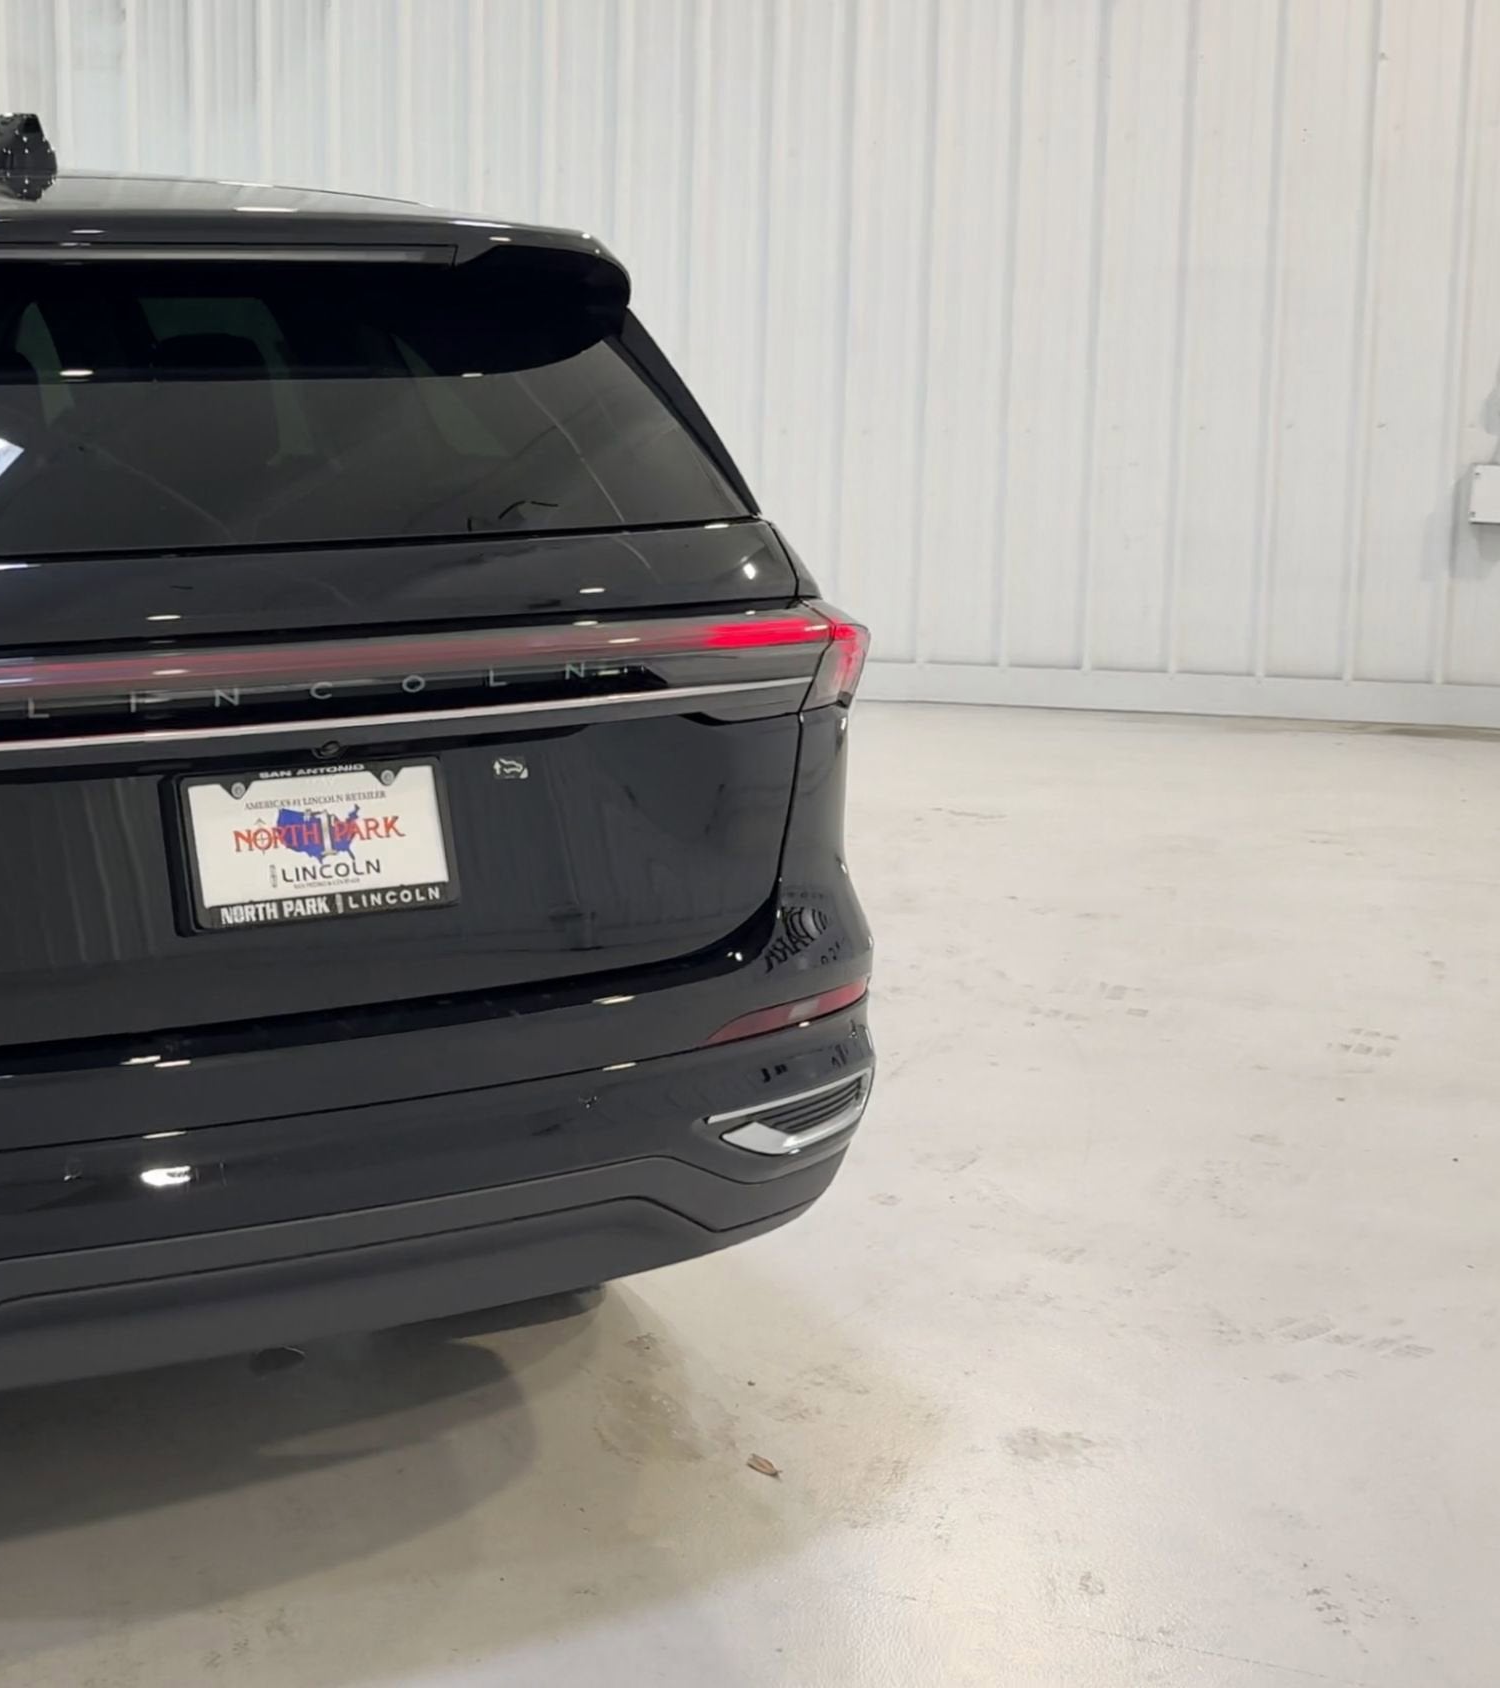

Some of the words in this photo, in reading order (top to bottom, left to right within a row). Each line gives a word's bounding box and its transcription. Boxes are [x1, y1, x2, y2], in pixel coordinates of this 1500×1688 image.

[27, 661, 586, 718] LINCOLN
[259, 769, 292, 779] SAN
[296, 763, 365, 776] ANTONIO
[302, 794, 344, 806] LINCOLN
[345, 790, 387, 802] RETAILER
[233, 821, 321, 853] NORTH
[332, 816, 406, 844] PARK
[281, 859, 381, 883] LINCOLN
[220, 900, 278, 925] NORTH
[283, 896, 331, 920] PARK
[349, 887, 441, 909] LINCOLN
